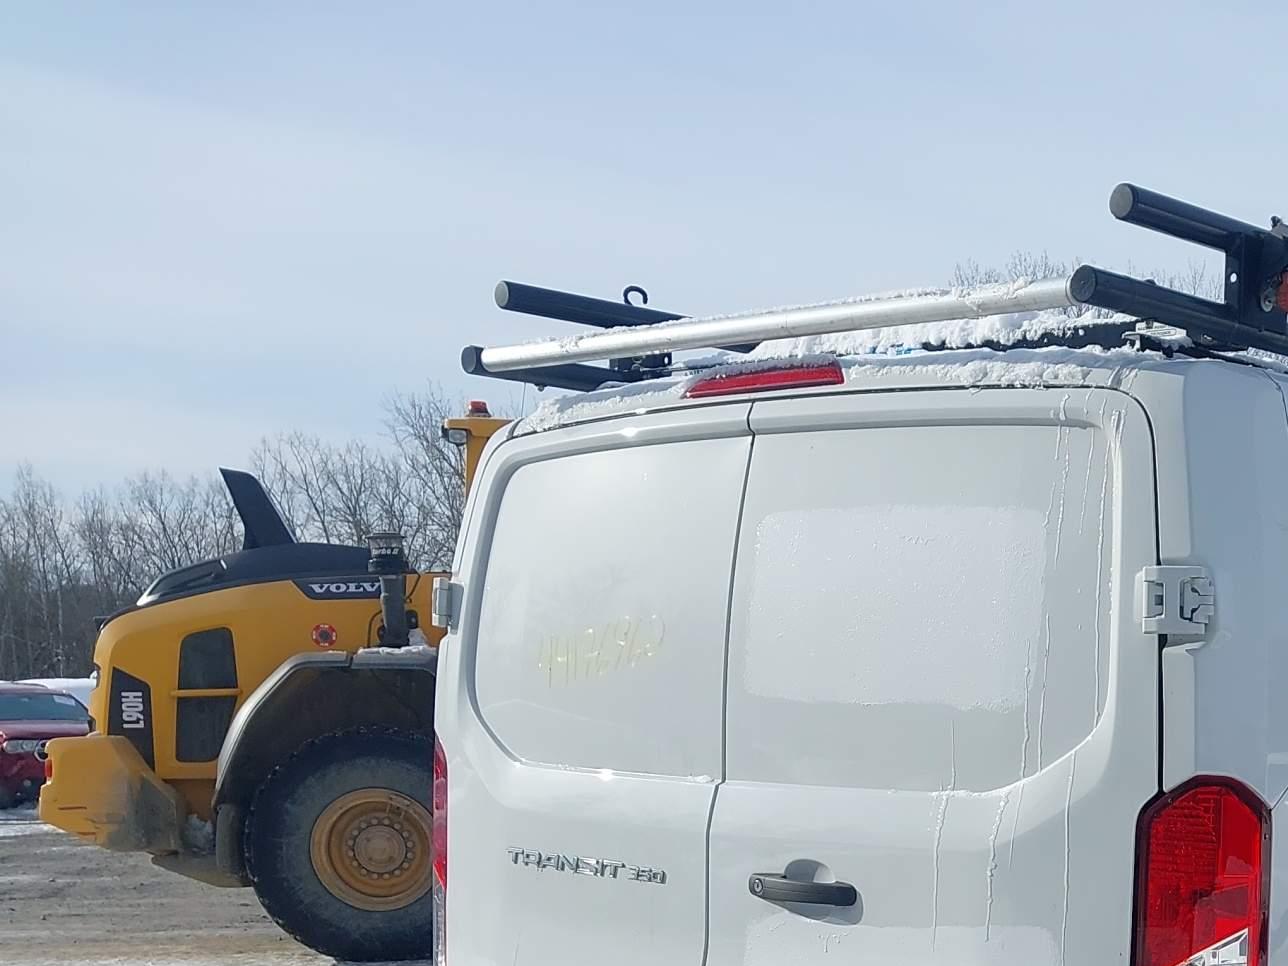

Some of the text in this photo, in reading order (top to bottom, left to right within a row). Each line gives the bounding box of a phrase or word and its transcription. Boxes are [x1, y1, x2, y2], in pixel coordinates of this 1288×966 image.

[308, 582, 381, 594] VOLV
[121, 691, 144, 728] L90H
[507, 846, 667, 885] TRANSIT 350
